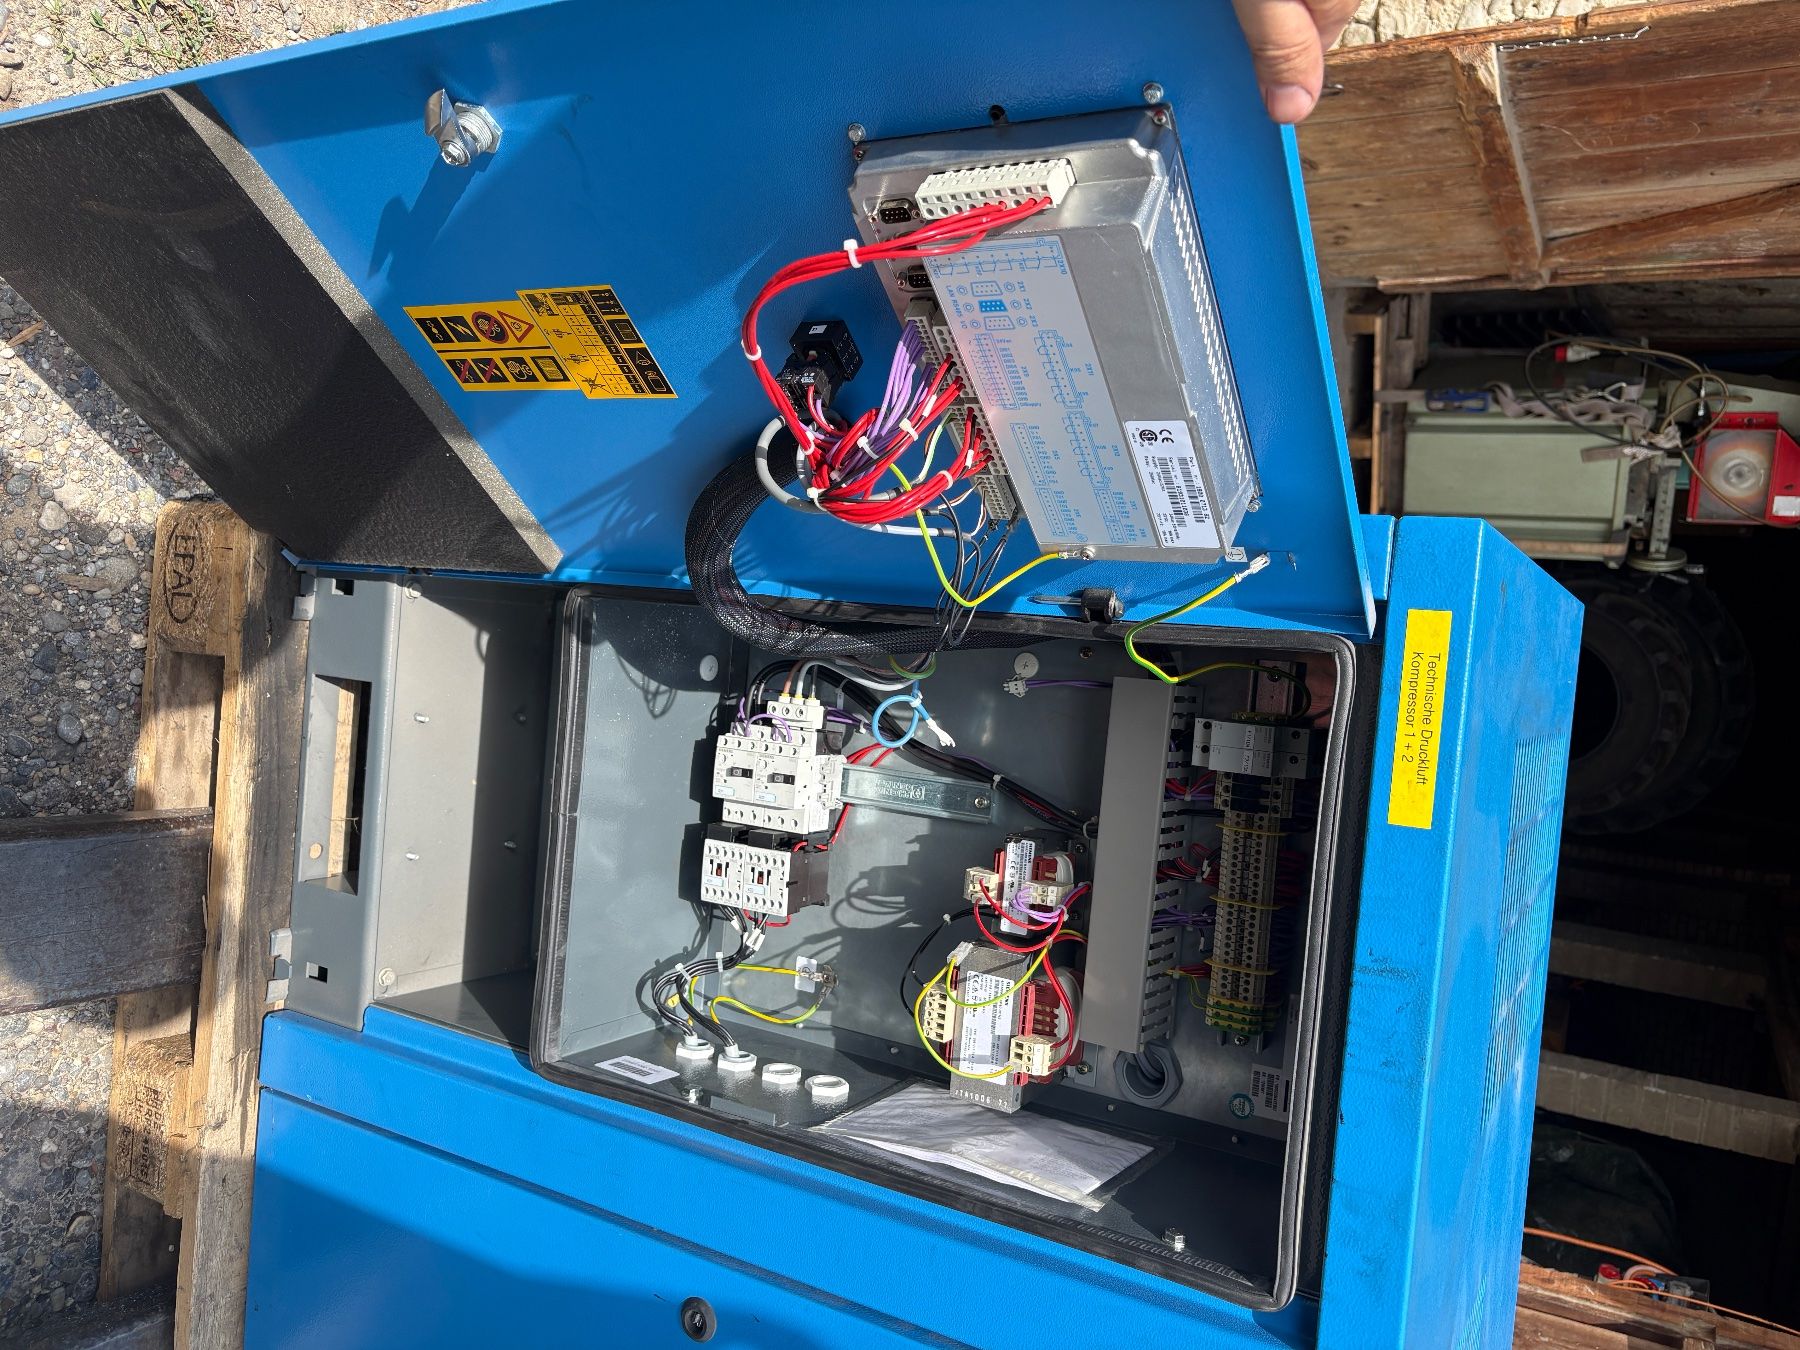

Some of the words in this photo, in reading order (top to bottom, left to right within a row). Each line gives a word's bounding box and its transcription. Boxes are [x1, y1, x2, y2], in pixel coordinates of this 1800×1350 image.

[171, 535, 196, 606] EPAL
[1406, 651, 1424, 728] Kompressor
[1422, 652, 1441, 725] Technische
[1402, 754, 1414, 763] 2
[1404, 742, 1412, 750] +
[1416, 730, 1433, 785] Druckluft
